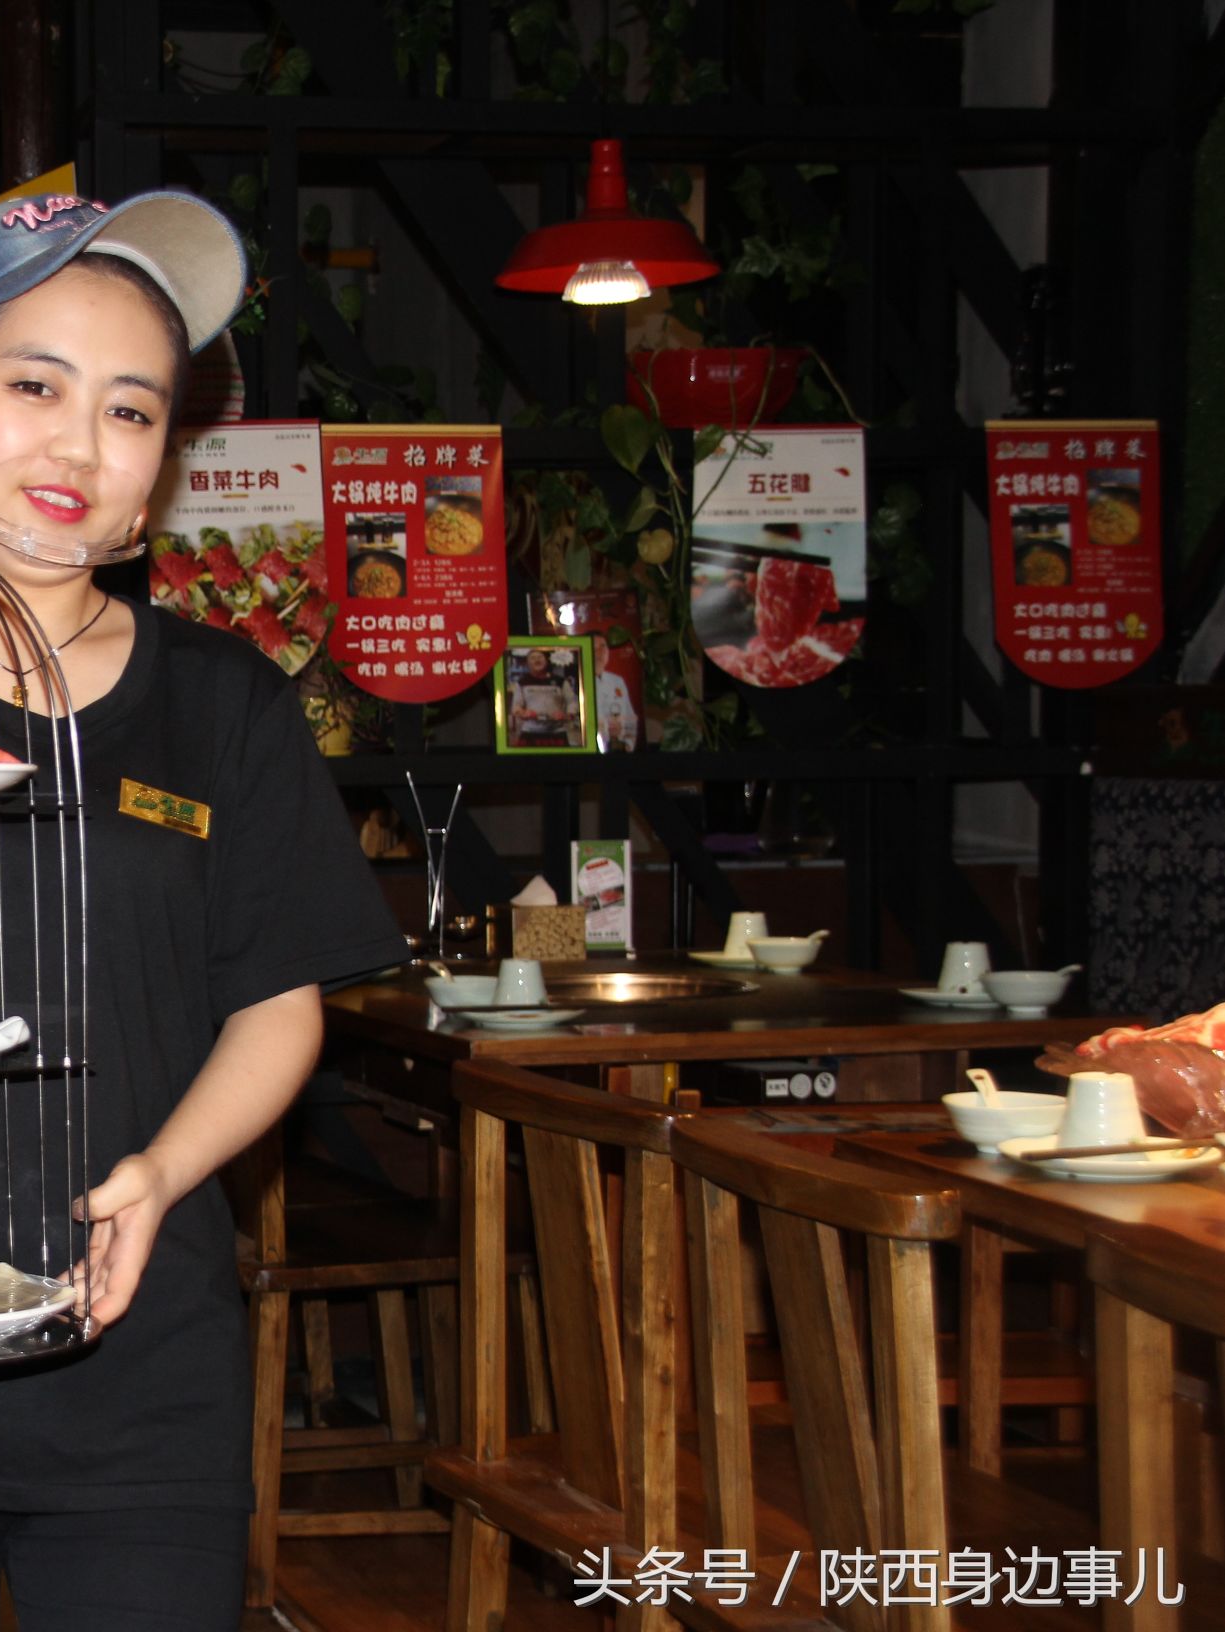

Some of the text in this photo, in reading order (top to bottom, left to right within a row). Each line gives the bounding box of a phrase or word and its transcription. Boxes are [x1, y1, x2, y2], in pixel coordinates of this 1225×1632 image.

[402, 444, 490, 469] 招牌菜
[1064, 438, 1147, 461] 招牌菜
[190, 470, 279, 491] 香菜牛肉
[748, 473, 811, 494] 五花腱
[995, 473, 1082, 496] 大锅炖牛肉
[331, 480, 418, 505] 大锅炖牛肉
[345, 614, 445, 632] 大口吃肉过瘾
[1013, 625, 1072, 641] 一锅三吃
[346, 637, 407, 654] 一锅三吃
[1023, 648, 1053, 663] 吃肉
[357, 658, 478, 677] 吃肉 喝汤 涮火锅
